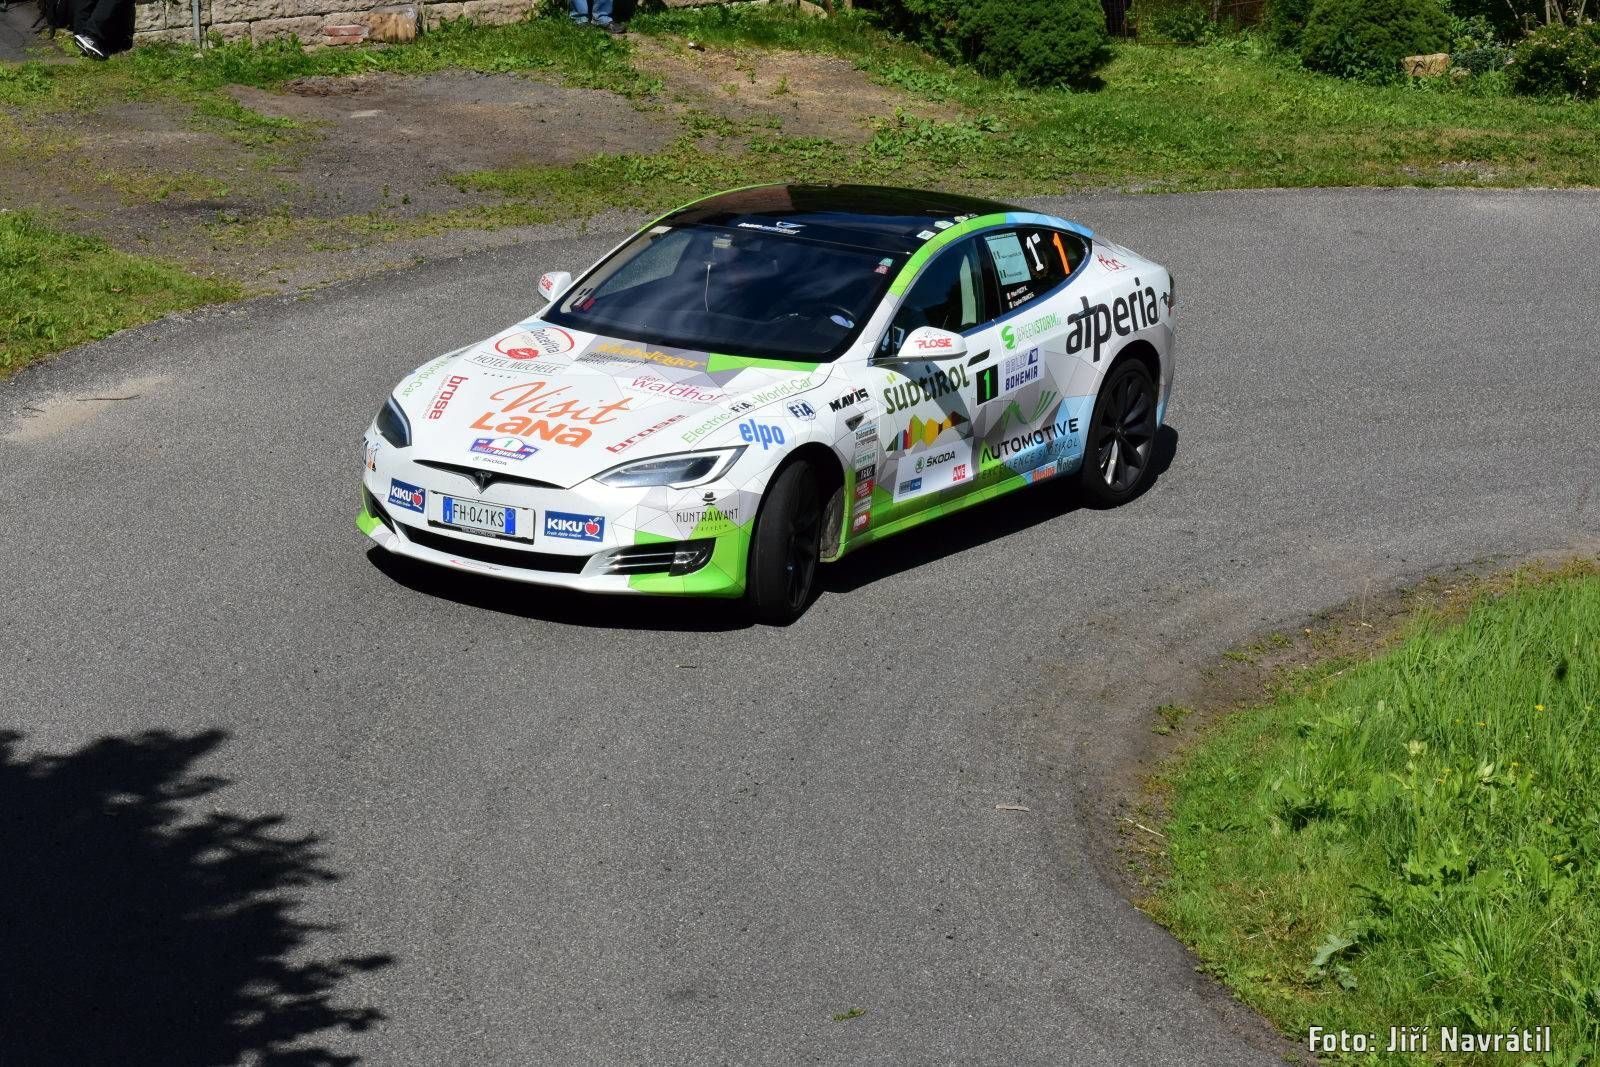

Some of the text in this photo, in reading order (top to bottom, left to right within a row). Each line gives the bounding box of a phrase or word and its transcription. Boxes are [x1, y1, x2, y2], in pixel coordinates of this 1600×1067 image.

[1053, 232, 1071, 275] 1
[1066, 276, 1160, 363] alperia
[914, 338, 952, 349] PLOSE
[983, 369, 991, 400] 1
[1005, 365, 1038, 391] BOHEMIA
[428, 376, 469, 420] brose
[489, 381, 633, 425] Visit
[739, 419, 785, 450] elpo
[982, 417, 1080, 464] AUTOMOTIVE
[926, 451, 956, 467] ŠKODA
[390, 485, 412, 502] KIKU
[547, 518, 583, 533] KIKU
[676, 508, 739, 523] KUNTRAWANT
